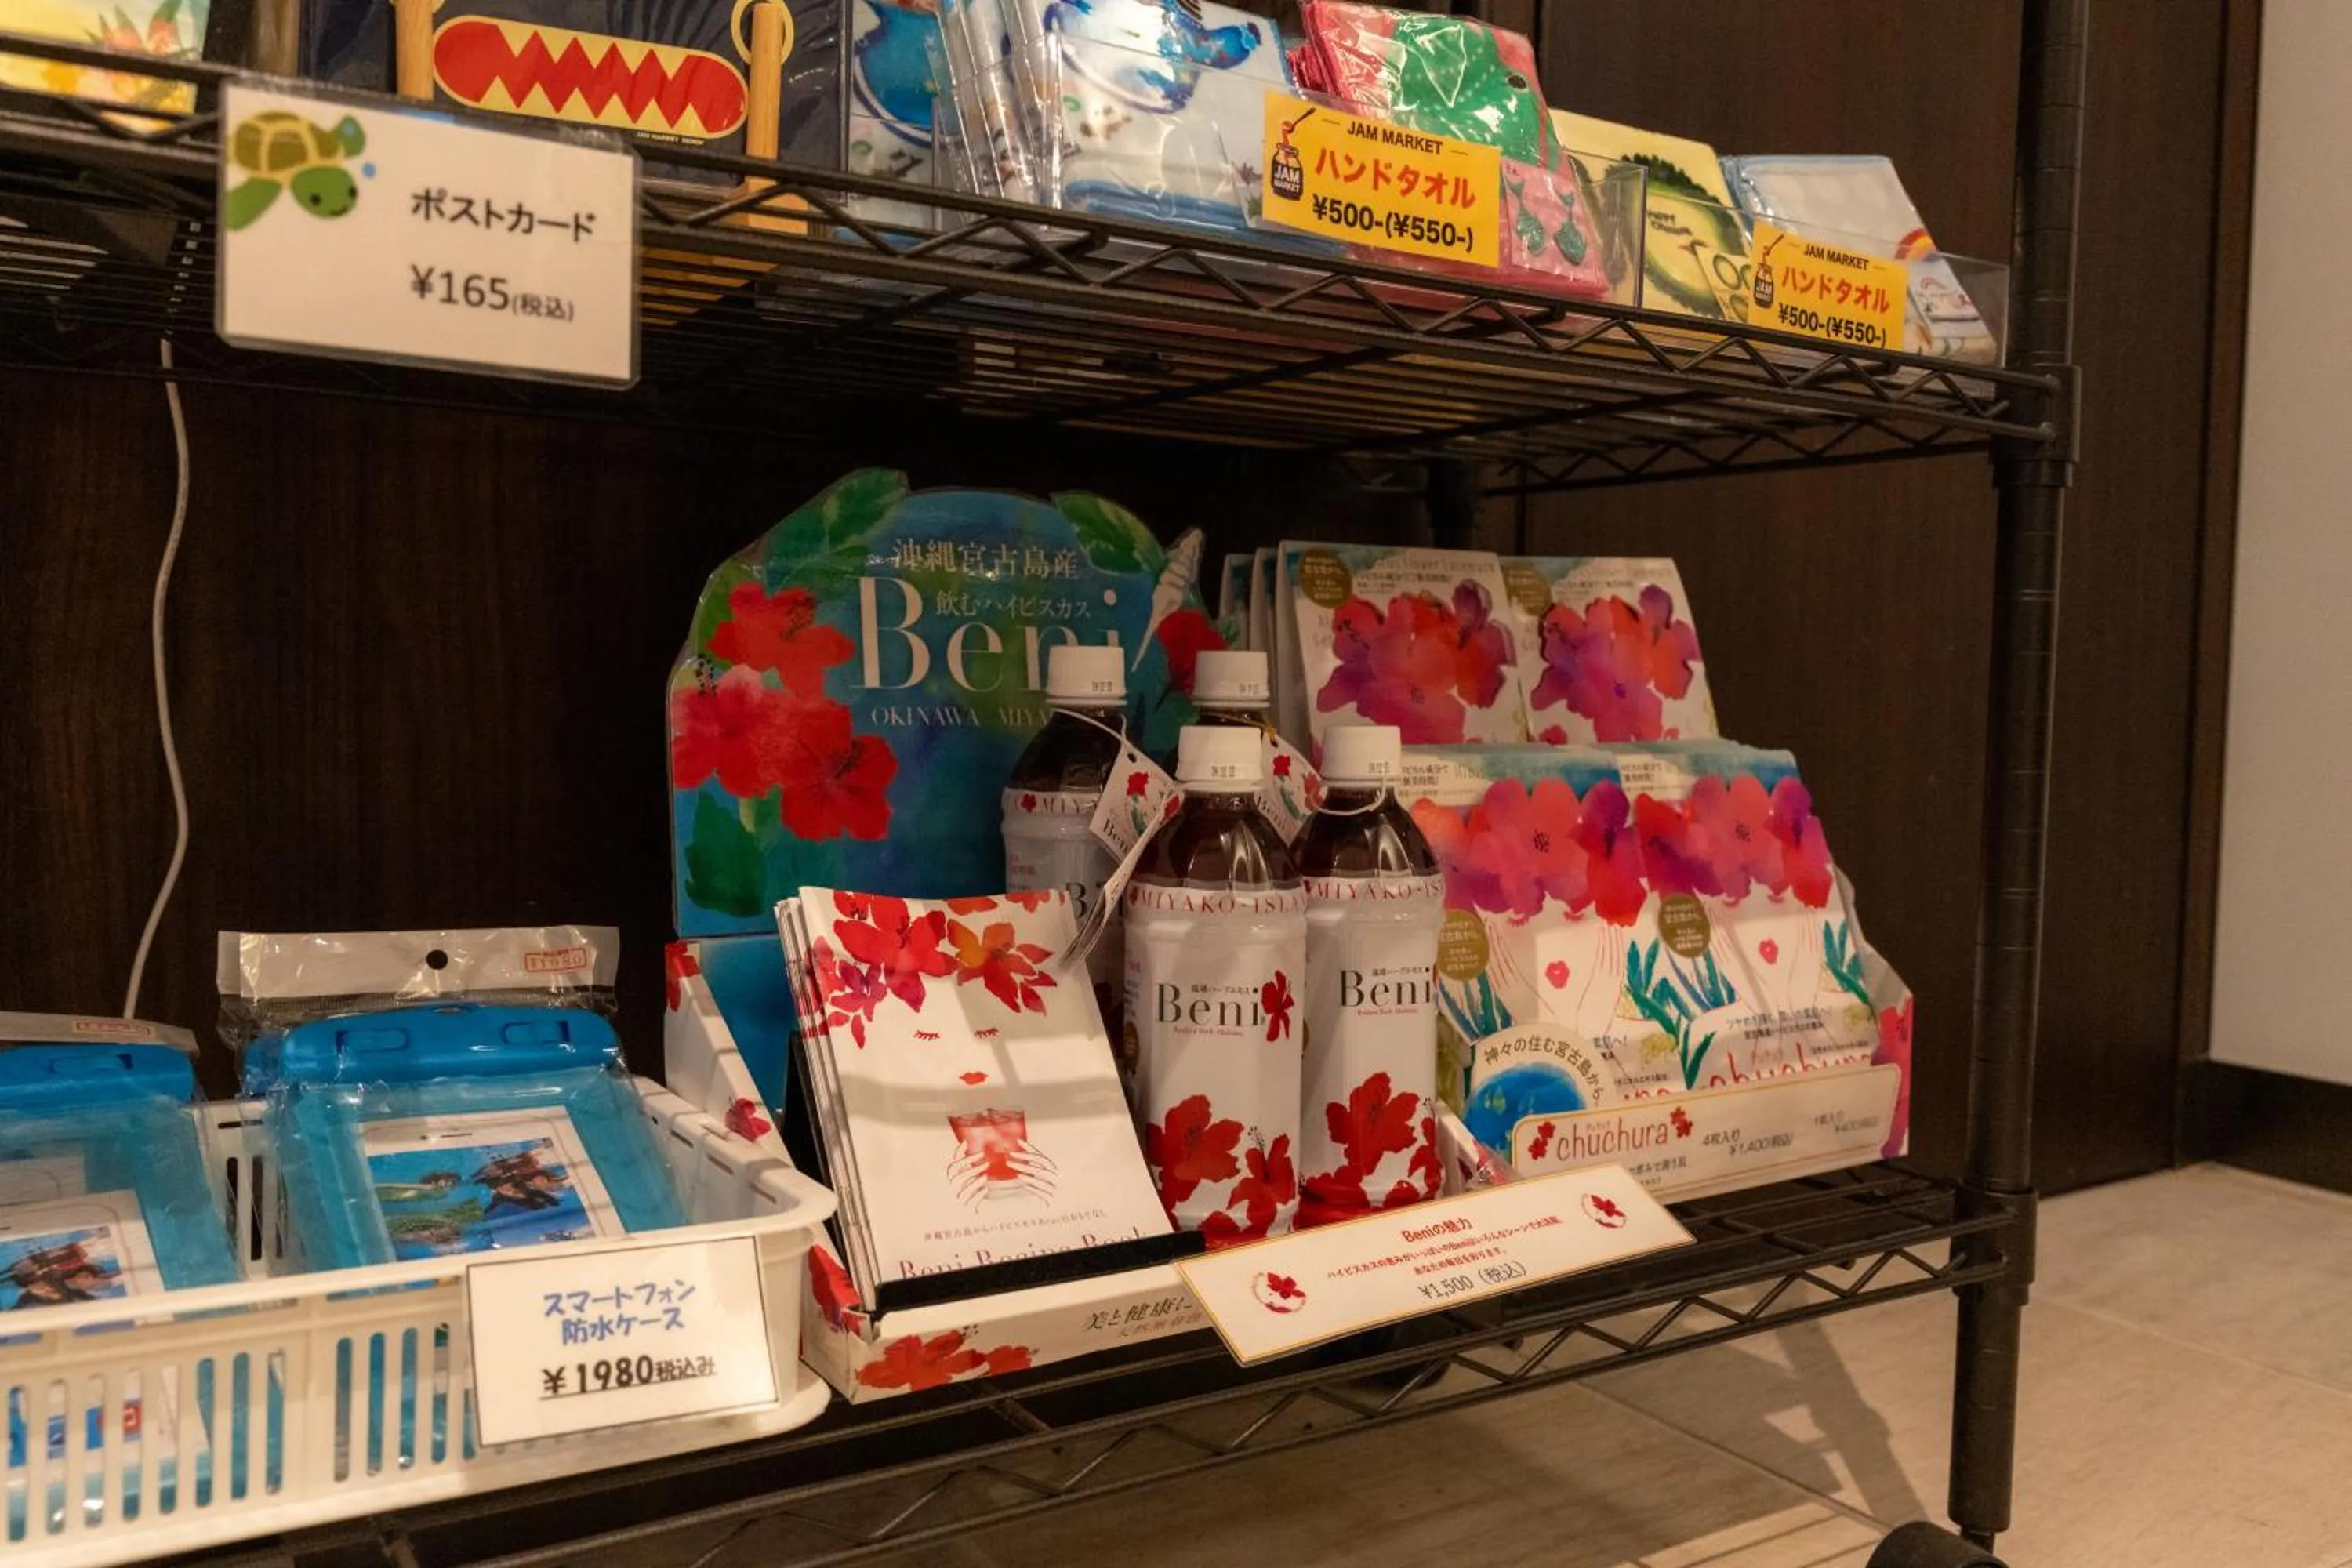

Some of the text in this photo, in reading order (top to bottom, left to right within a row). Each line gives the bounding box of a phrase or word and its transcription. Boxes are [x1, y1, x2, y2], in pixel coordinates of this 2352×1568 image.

[1348, 121, 1443, 155] JAM MARKET
[1274, 165, 1301, 183] JAM
[1274, 180, 1301, 194] MARKET
[1314, 147, 1475, 209] ハンドタオル
[411, 187, 596, 243] ポストカード
[1312, 193, 1474, 253] ¥500-(¥550-)
[1804, 244, 1870, 271] JAM MARKET
[1780, 265, 1890, 314] ハンドタオル
[1777, 302, 1887, 348] ¥500-(¥550-)
[892, 539, 1080, 580] 沖縄宮古島産
[935, 590, 1092, 619] 飲むハイビスカス
[871, 706, 981, 728] OKINAWA
[1157, 982, 1258, 1027] Beni
[1340, 966, 1430, 1008] Beni
[1483, 1034, 1604, 1100] 神々の住む宮古島から
[1556, 1116, 1668, 1162] chuchura
[1401, 1216, 1474, 1243] Beniの魅力
[543, 1278, 697, 1318] スマートフォン
[561, 1307, 685, 1346] 防水ケース
